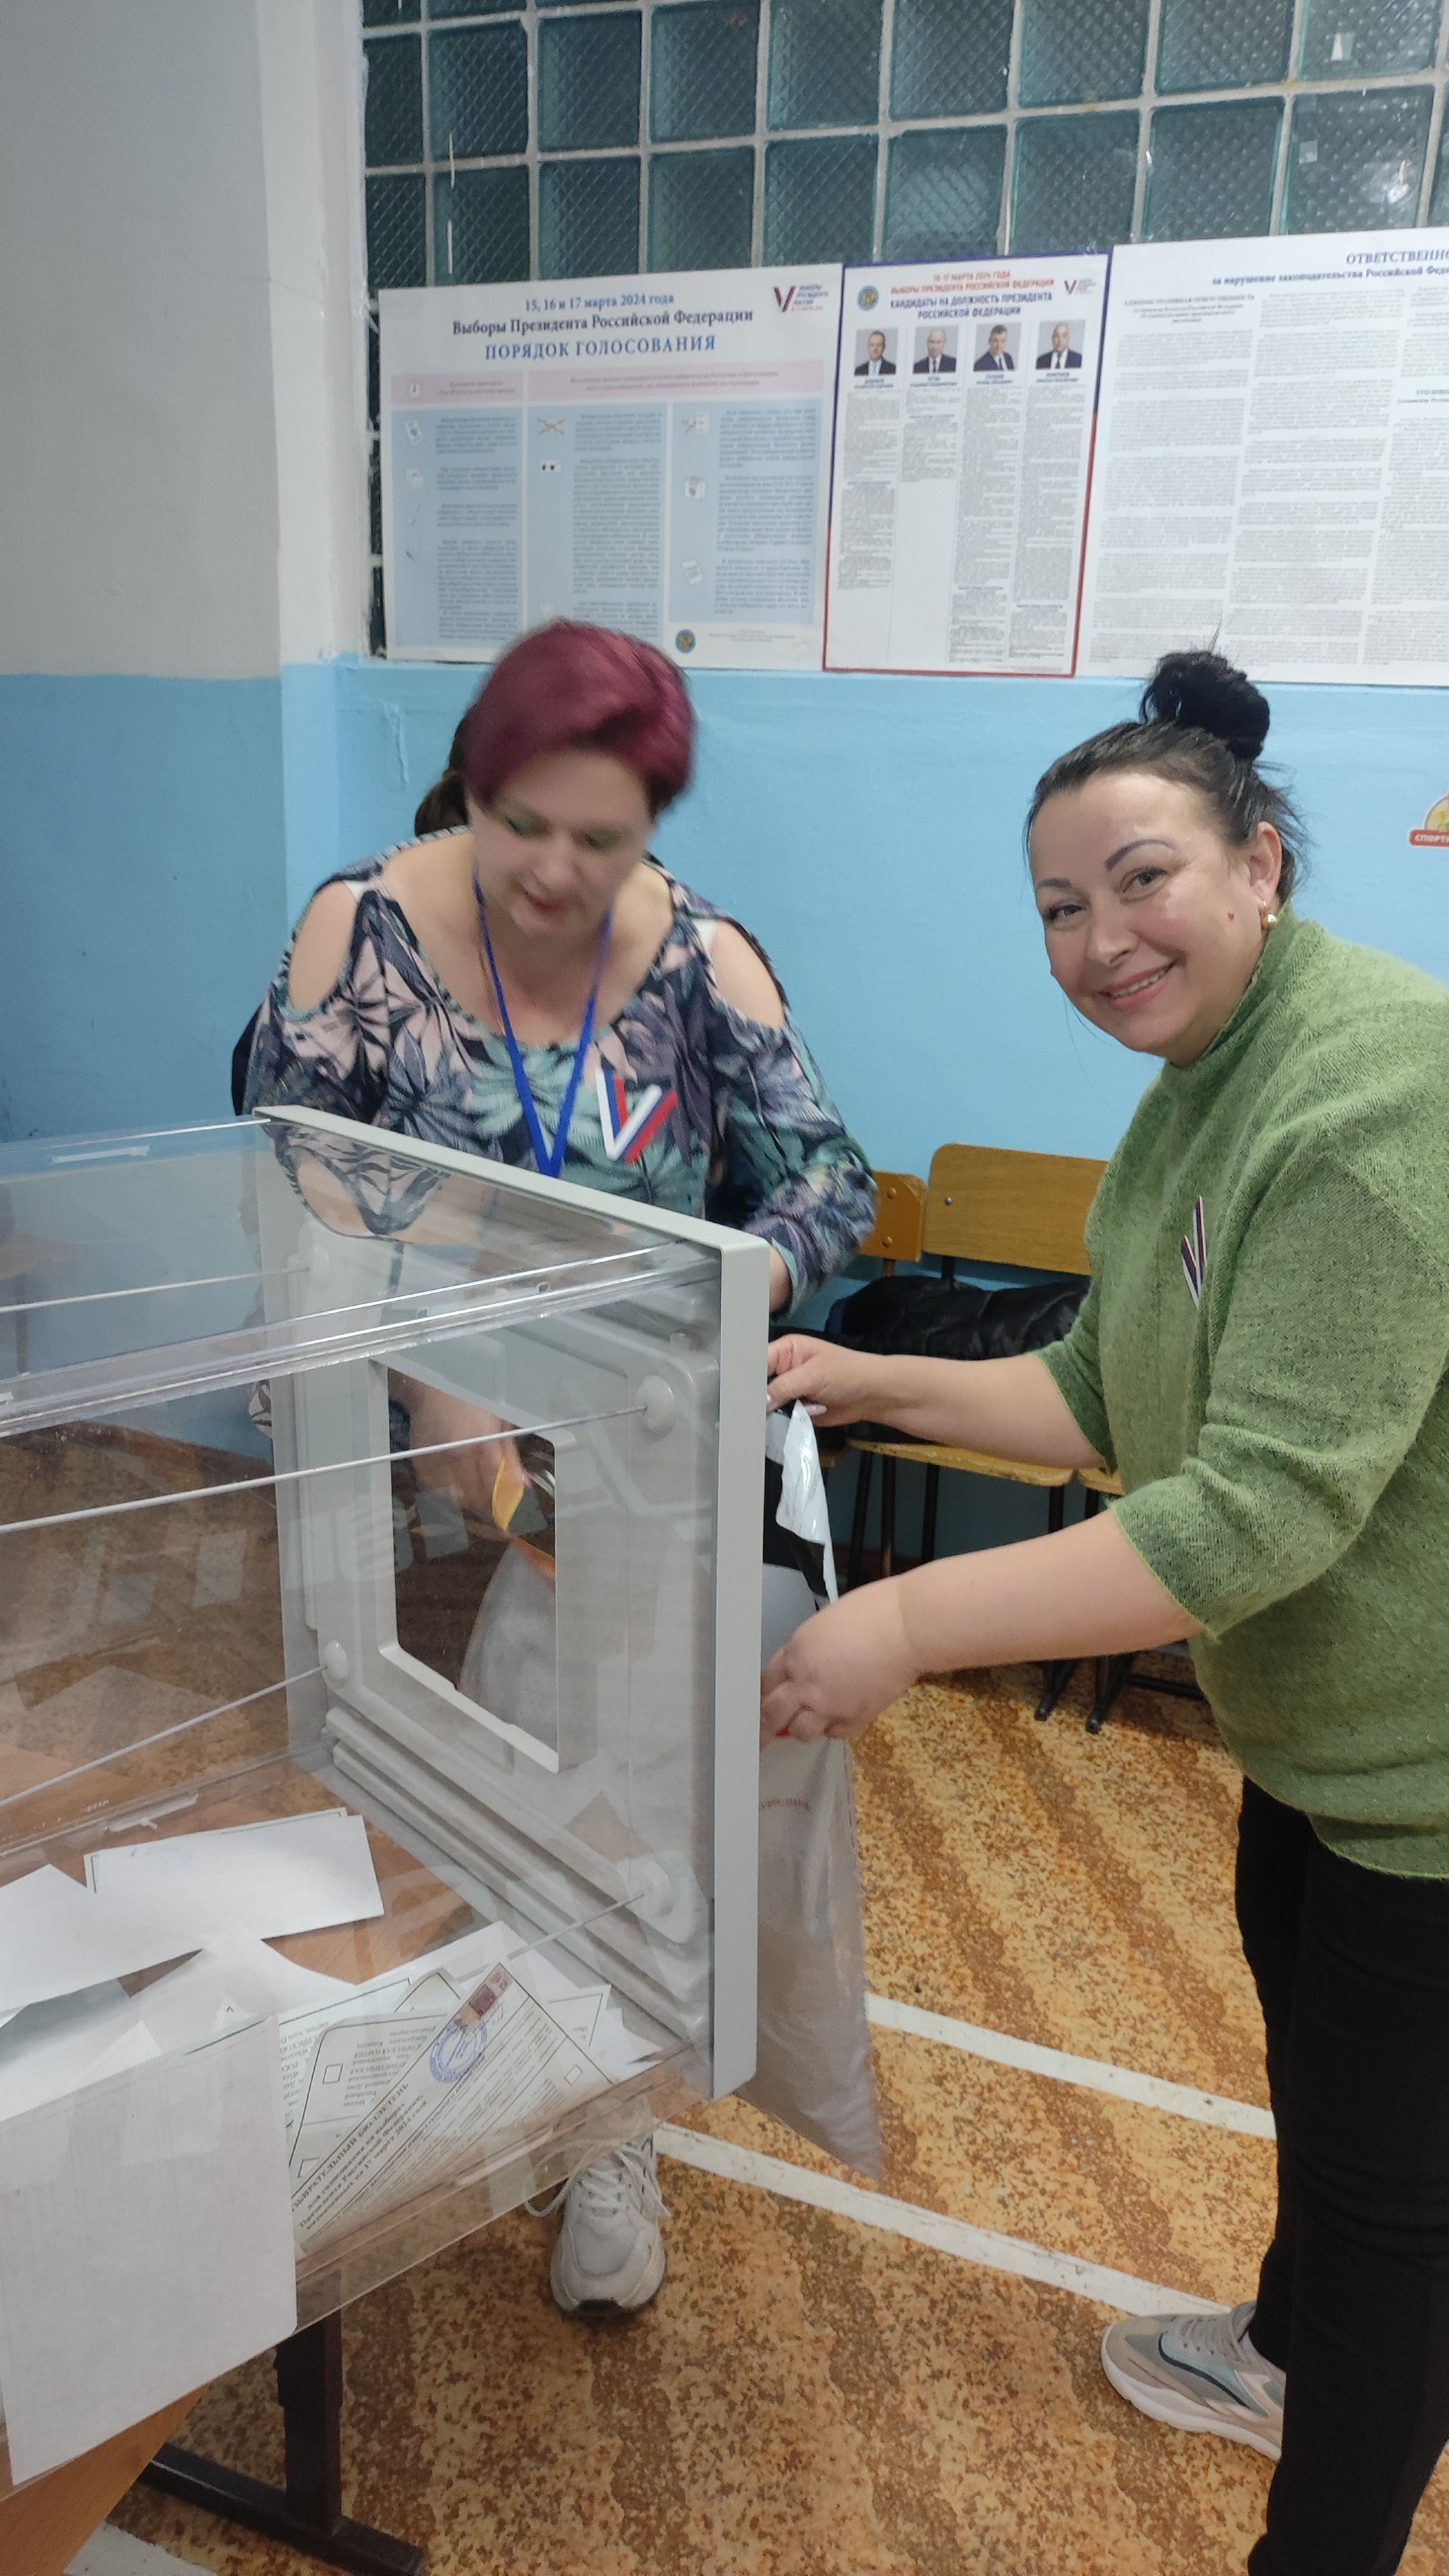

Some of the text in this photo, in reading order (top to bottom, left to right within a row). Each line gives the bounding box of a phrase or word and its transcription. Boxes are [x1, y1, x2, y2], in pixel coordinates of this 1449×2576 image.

[1366, 266, 1423, 278] Российской
[525, 293, 674, 312] 15, 16 и 17 марта 2024 года
[453, 310, 753, 337] Выборы Президента Российской Федерации
[485, 335, 716, 361] ПОРЯДОК ГОЛОСОВАНИЯ
[288, 2137, 358, 2212] ЗБИРАТЕЛЬНЫЙ
